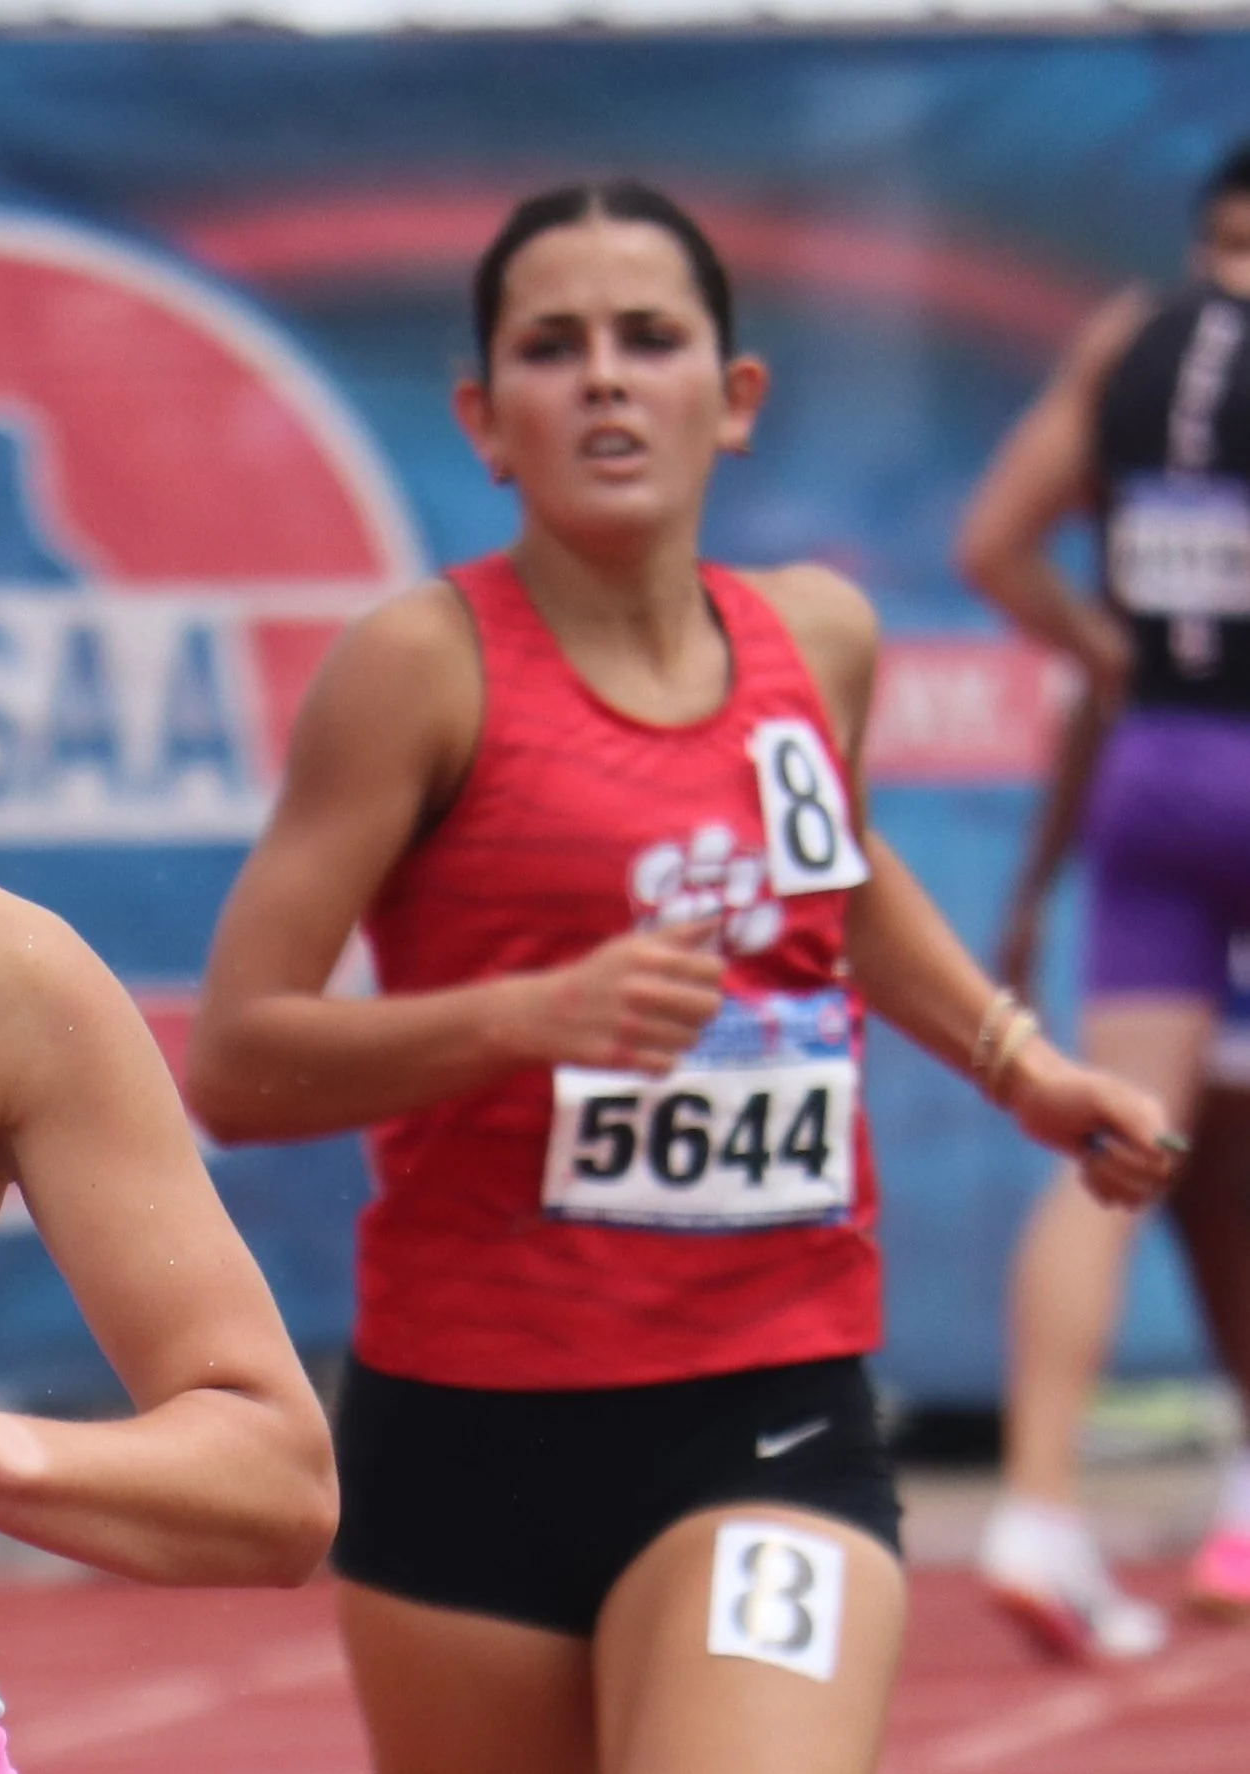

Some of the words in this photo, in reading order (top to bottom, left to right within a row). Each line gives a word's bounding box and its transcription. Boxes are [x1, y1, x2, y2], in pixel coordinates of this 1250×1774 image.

[775, 739, 837, 872] 8
[572, 1088, 830, 1186] 5644
[732, 1541, 814, 1655] 8
